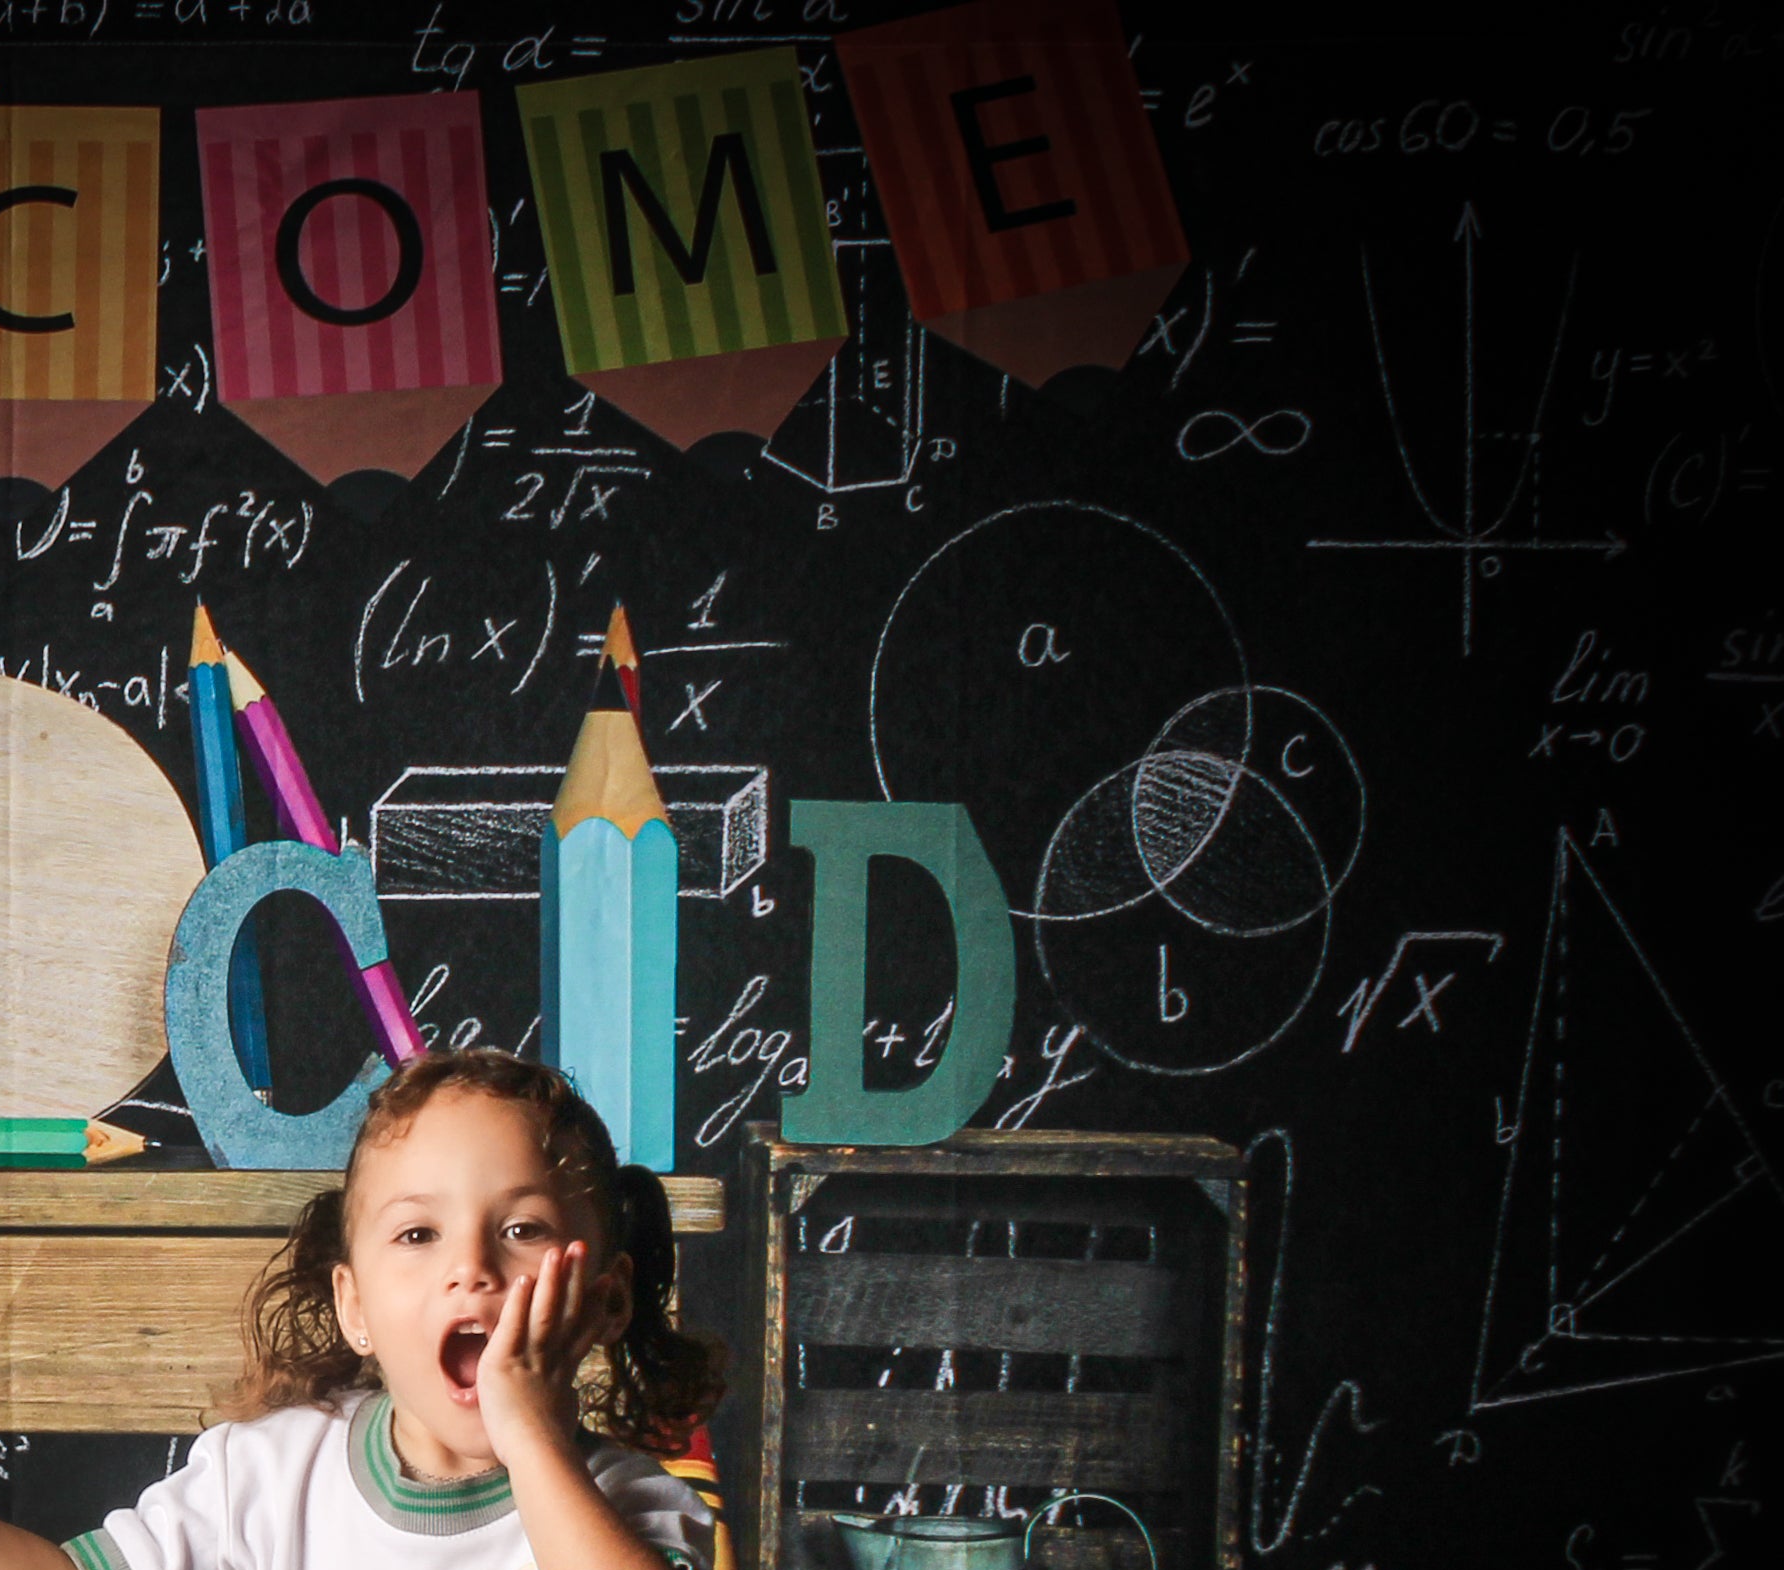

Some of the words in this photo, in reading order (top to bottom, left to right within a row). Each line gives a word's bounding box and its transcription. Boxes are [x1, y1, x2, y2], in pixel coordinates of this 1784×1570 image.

[1017, 622, 1072, 668] a
[164, 838, 392, 1172] C
[779, 798, 1017, 1147] D
